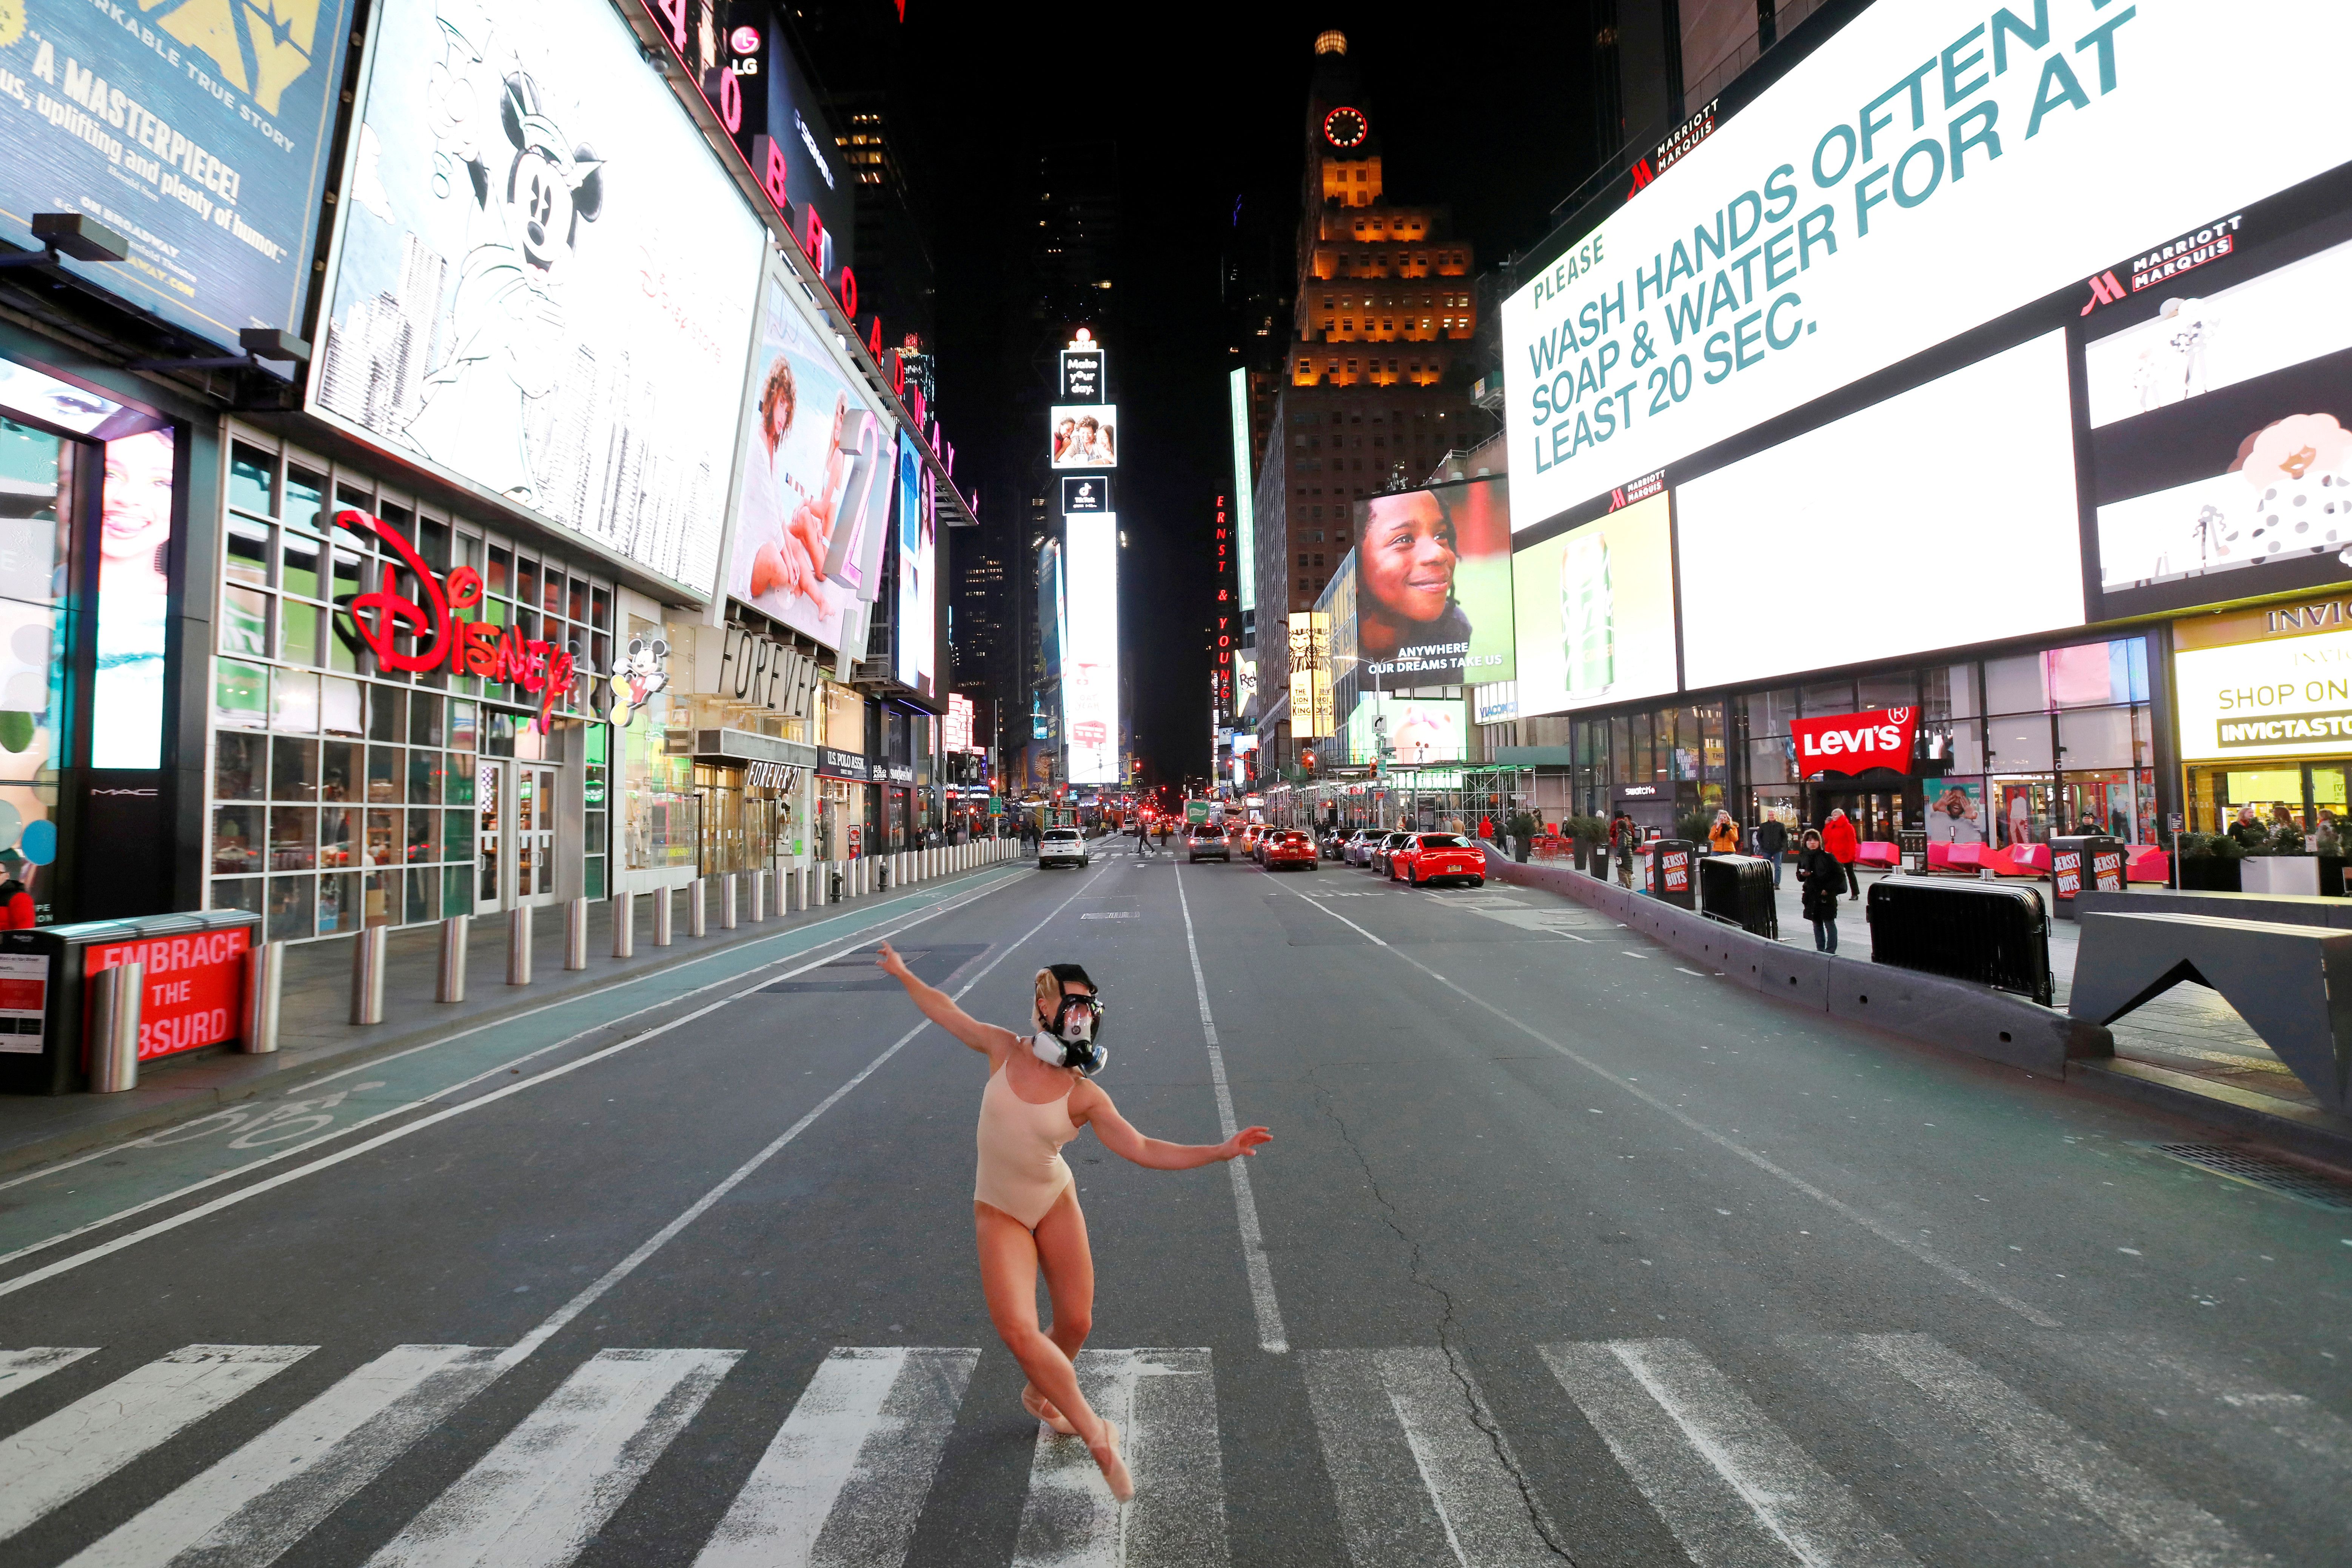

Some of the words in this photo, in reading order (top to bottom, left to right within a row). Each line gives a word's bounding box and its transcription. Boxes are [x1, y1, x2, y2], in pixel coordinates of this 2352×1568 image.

[89, 0, 181, 68] RKABLE
[187, 61, 235, 109] TRUE
[240, 104, 295, 154] STORY
[732, 58, 758, 75] LG
[63, 57, 240, 206] MASTERPIECE!
[1657, 98, 1719, 158] MARRIOTT
[1658, 120, 1714, 173] MARQUIS
[37, 92, 123, 164] uplifting
[125, 147, 160, 185] and
[160, 174, 215, 221] plenty
[214, 204, 234, 230] of
[1529, 282, 1625, 379] WASH
[1636, 163, 1797, 312] HANDS
[1812, 0, 2050, 188] OFTEN
[80, 196, 102, 214] ON
[103, 208, 180, 258] BROADWAY
[1532, 345, 1620, 426] SOAP
[1631, 320, 1657, 368] &
[1665, 203, 1838, 346] WATER
[1854, 100, 2003, 239] FOR
[2024, 5, 2136, 140] AT
[2133, 215, 2242, 273] MARRIOTT
[1534, 234, 1605, 310] PLEASE
[2135, 239, 2230, 288] MARQUIS
[1067, 358, 1098, 369] Make
[1069, 370, 1095, 384] your
[1071, 382, 1094, 395] day.
[1535, 385, 1643, 475] LEAST
[1649, 354, 1692, 417] 20
[1704, 292, 1817, 385] SEC.
[1628, 470, 1665, 492] MARRIOTT
[1628, 482, 1661, 502] MARQUIS
[1217, 495, 1226, 572] ERNST
[1218, 589, 1228, 601] &
[1218, 617, 1231, 698] YOUNG
[1398, 642, 1468, 658] ANYWHERE
[717, 620, 819, 720] FOREVER
[1368, 663, 1394, 675] OUR
[1397, 659, 1448, 673] DREAMS
[1450, 656, 1482, 668] TAKE
[1485, 654, 1502, 665] US
[1293, 696, 1308, 705] LION
[2219, 682, 2295, 710] SHOP
[2306, 678, 2348, 702] ON
[1292, 705, 1311, 716] KING
[827, 751, 837, 766] U.S.
[837, 753, 851, 768] POLO
[851, 756, 865, 770] ASSN.
[747, 761, 789, 790] FOREVER
[789, 767, 801, 790] 21
[890, 766, 906, 784] sunglass
[1625, 786, 1651, 795] swatch
[1662, 852, 1688, 869] JERSEY
[2054, 852, 2081, 872] JERSEY
[2093, 853, 2120, 873] JERSEY
[1665, 870, 1687, 887] BOYS
[2057, 874, 2080, 893] BOYS
[2097, 875, 2119, 891] BOYS
[104, 932, 242, 974] EMBRACE
[152, 980, 191, 1006] THE
[138, 1008, 227, 1057] BSURD
